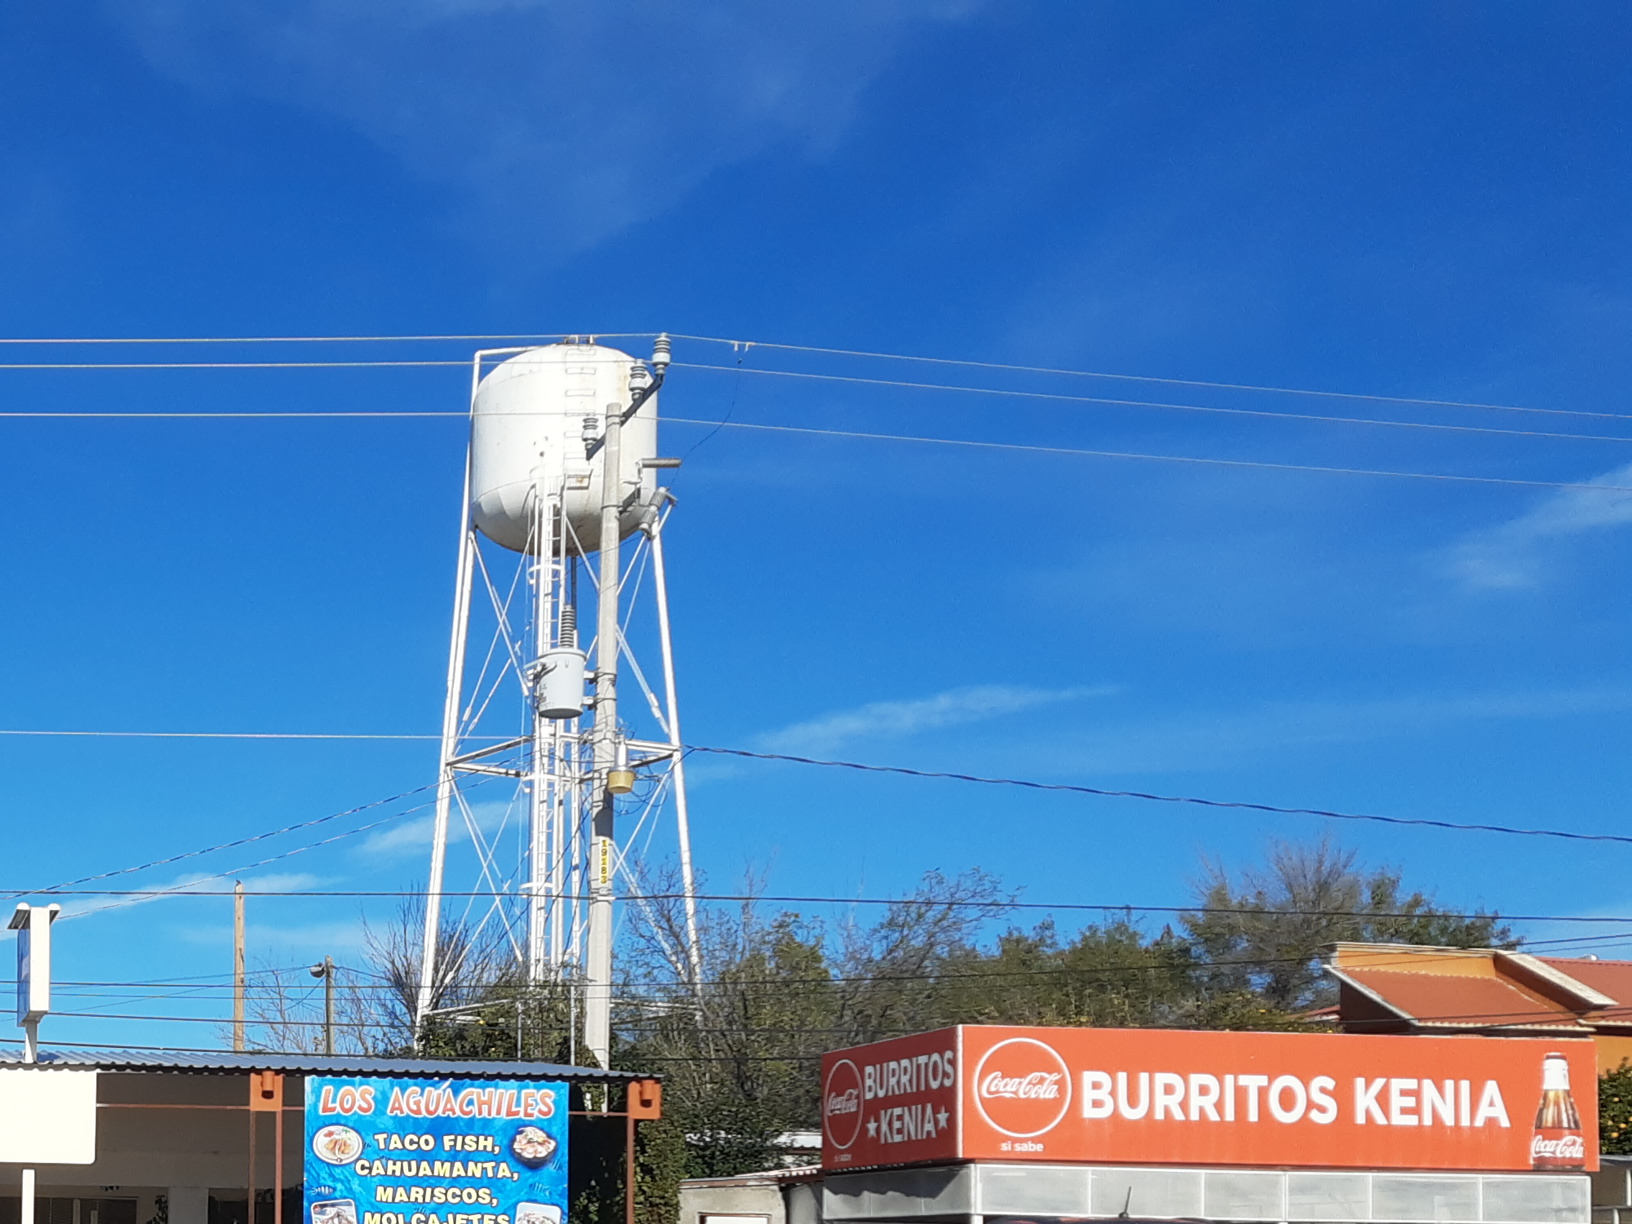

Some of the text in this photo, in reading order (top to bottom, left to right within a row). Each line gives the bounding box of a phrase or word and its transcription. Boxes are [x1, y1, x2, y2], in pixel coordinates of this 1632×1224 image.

[864, 1050, 954, 1100] BURRITOS
[981, 1070, 1063, 1099] Coca-Cola
[319, 1085, 555, 1119] LOS AGUACHILES
[1081, 1070, 1511, 1128] BURRITOS KENIA
[879, 1102, 937, 1144] KENIA
[374, 1133, 500, 1154] TACO FISH,
[1000, 1140, 1045, 1152] si sabe
[1531, 1135, 1585, 1158] Coca-Cola
[355, 1159, 519, 1181] CAHUAMANTA,
[375, 1186, 498, 1207] MARISCOS,
